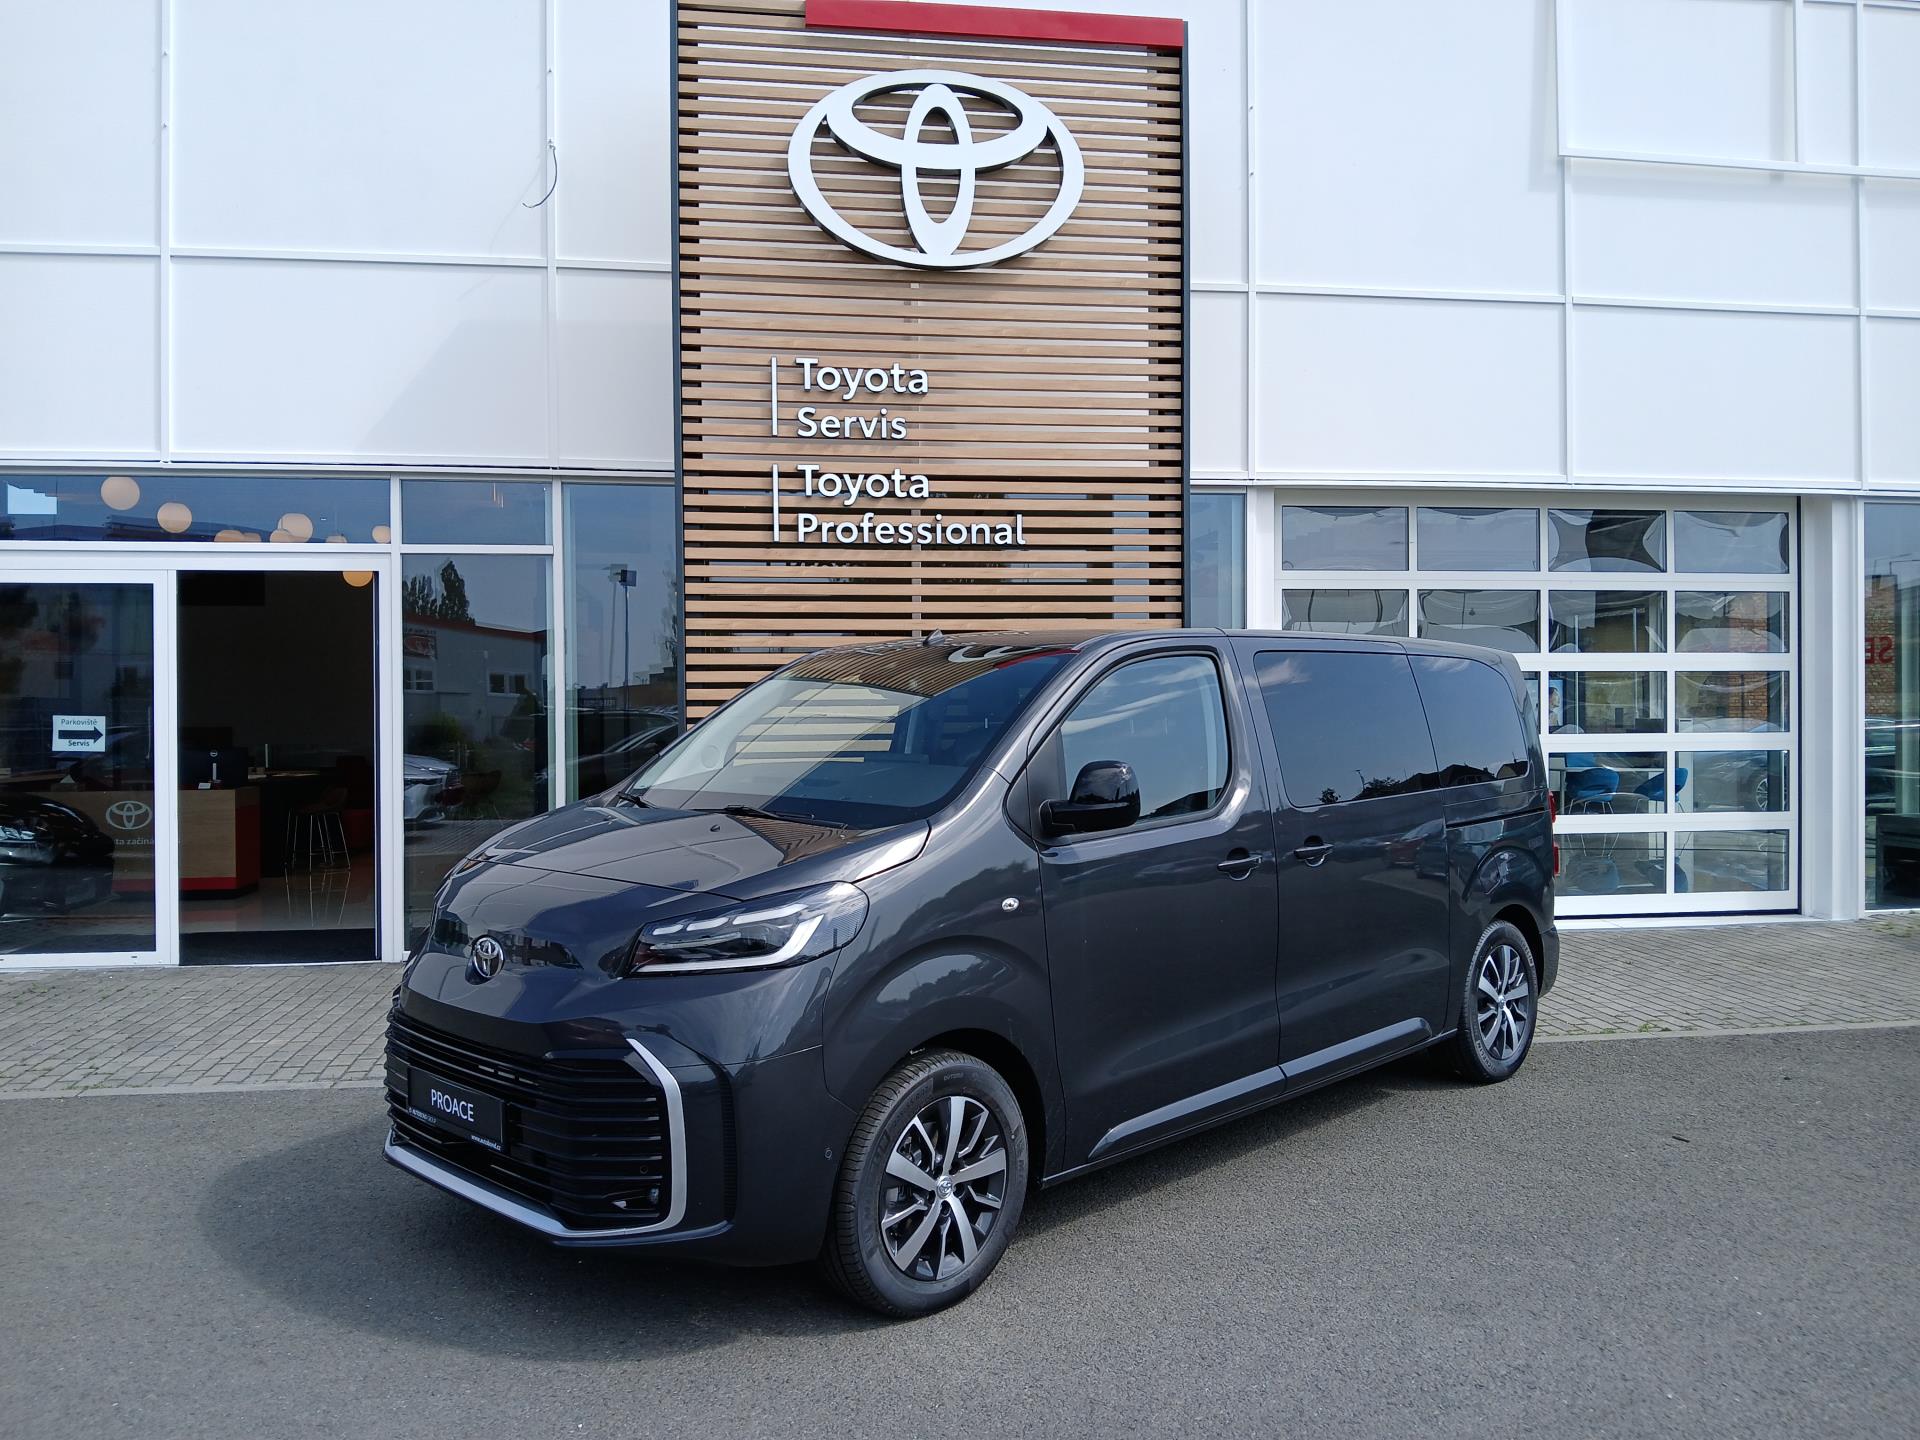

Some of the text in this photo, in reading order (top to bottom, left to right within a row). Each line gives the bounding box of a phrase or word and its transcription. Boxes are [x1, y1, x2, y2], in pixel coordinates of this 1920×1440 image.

[795, 356, 929, 400] Toyota
[796, 406, 907, 439] Servis
[796, 464, 930, 506] Toyota
[797, 512, 1026, 545] Professional
[60, 718, 98, 726] Parkoviště
[68, 739, 90, 747] Servis
[431, 1089, 474, 1122] PROACE
